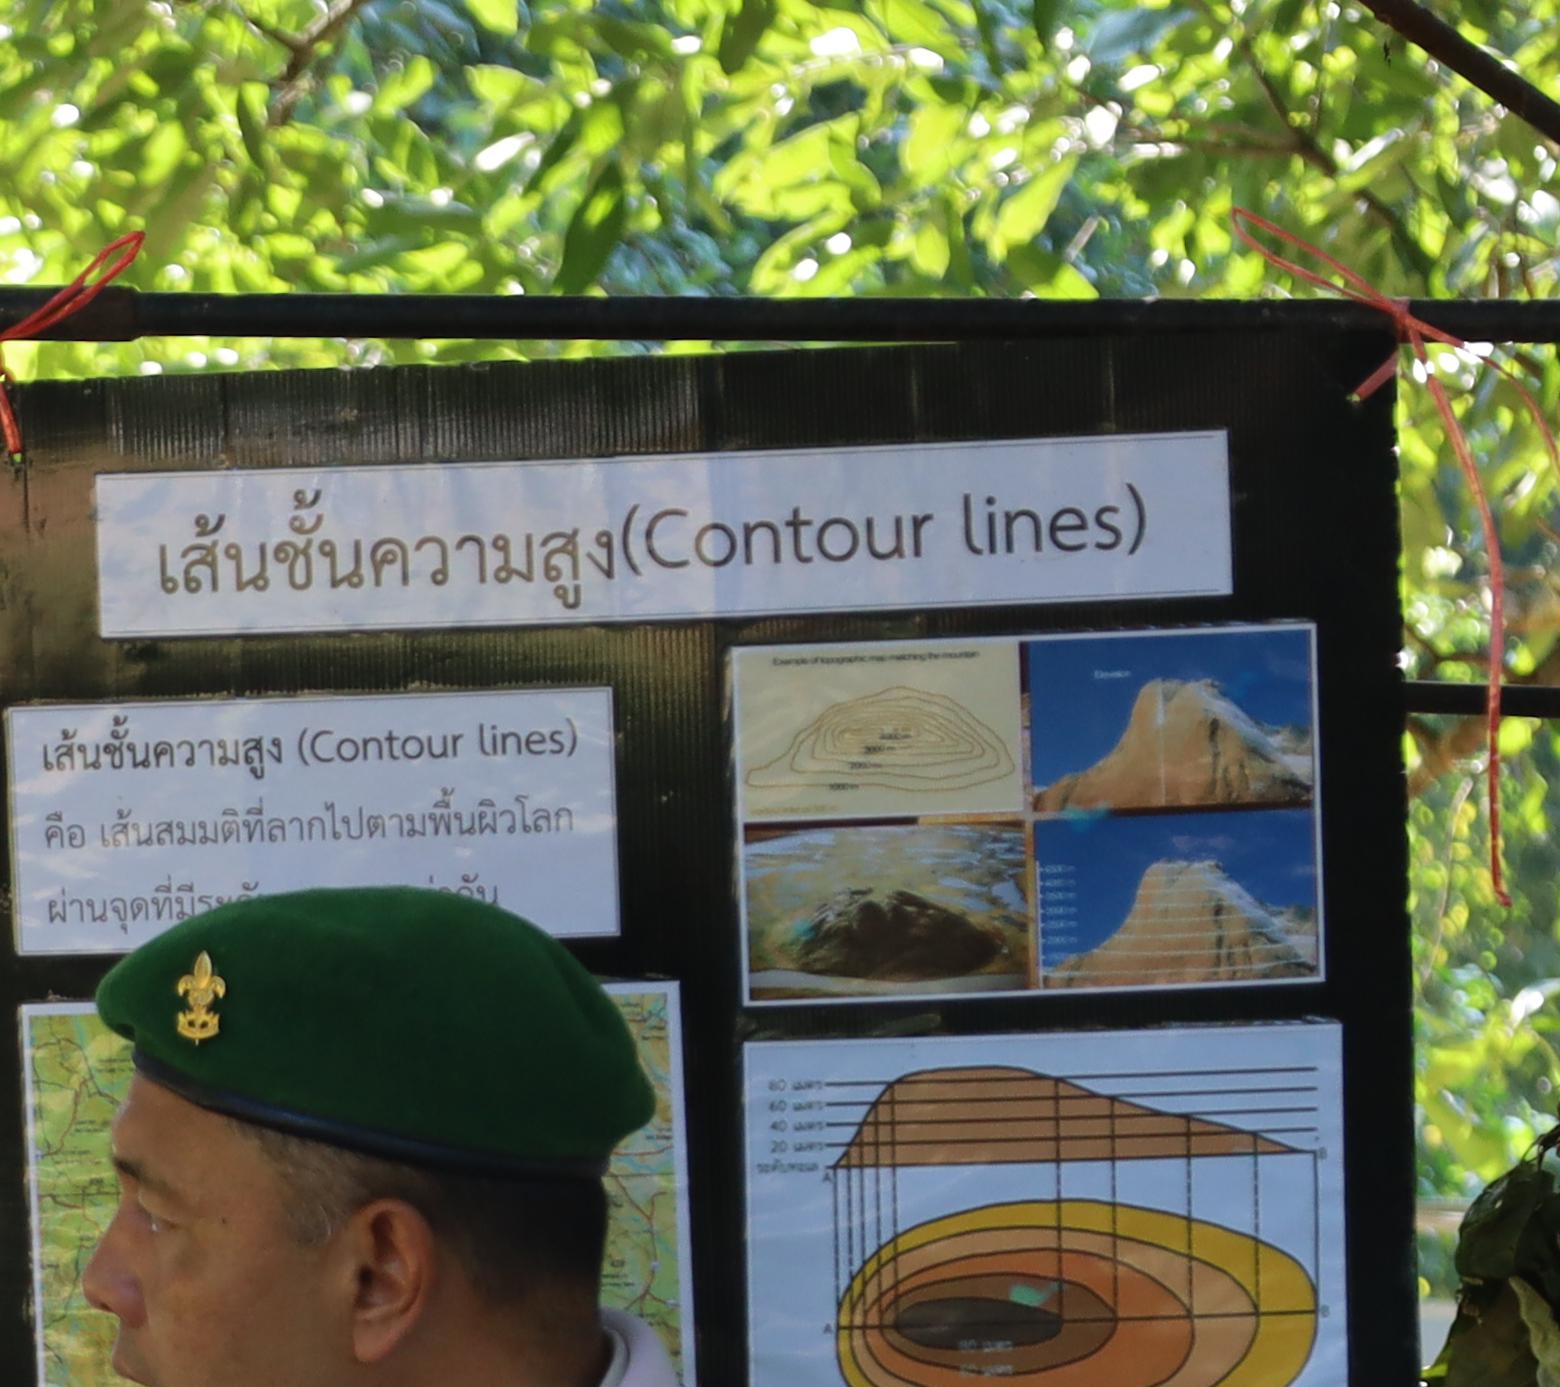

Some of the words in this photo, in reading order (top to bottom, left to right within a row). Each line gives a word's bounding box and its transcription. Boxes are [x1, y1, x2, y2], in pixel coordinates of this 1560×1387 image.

[964, 484, 1147, 556] lines)
[42, 715, 283, 781] เส้นชั้นความสูง
[297, 728, 464, 766] (Contour
[478, 716, 579, 758] lines)
[44, 811, 87, 849] คือ
[100, 786, 574, 847] เส้นสมมติที่ลากไปตามพื้นผิวโลก
